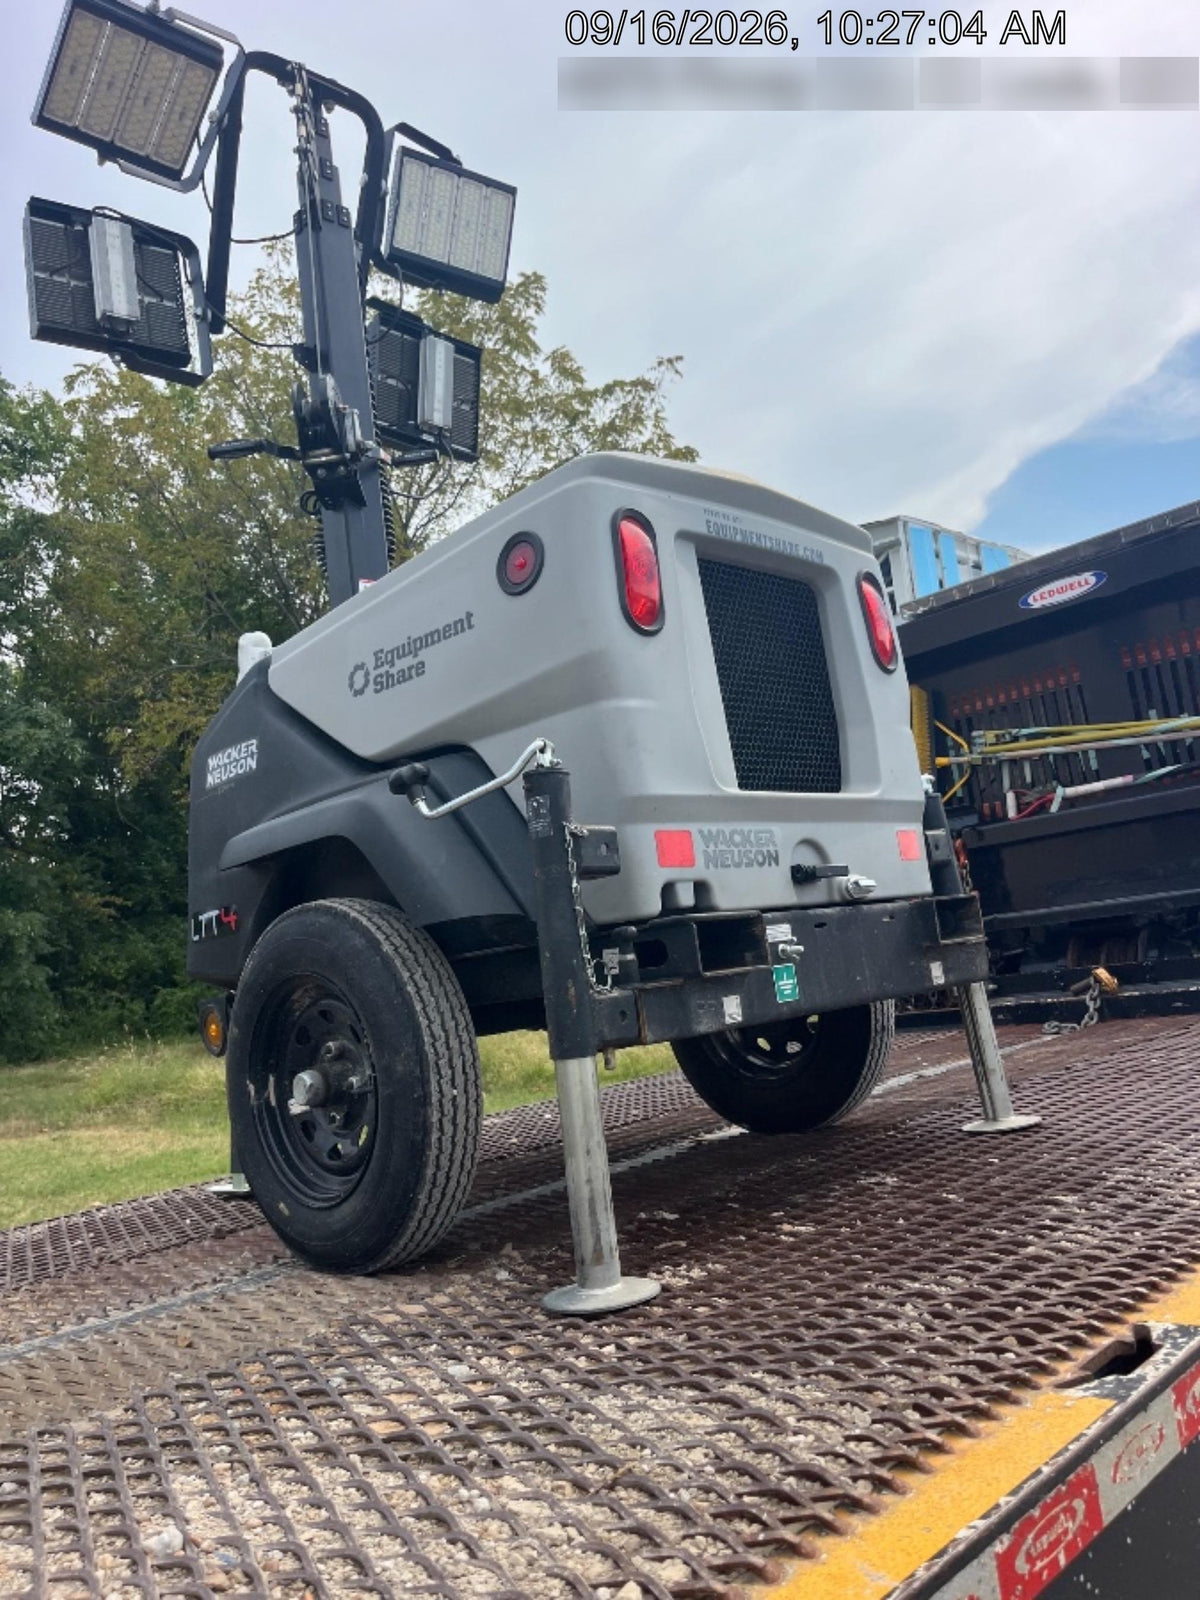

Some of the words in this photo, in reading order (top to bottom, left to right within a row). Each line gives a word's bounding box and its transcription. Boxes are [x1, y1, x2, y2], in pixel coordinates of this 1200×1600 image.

[1032, 577, 1092, 603] LEDWELL
[373, 610, 475, 671] Equipment
[373, 660, 426, 694] Share
[207, 739, 259, 771] WACKER
[206, 754, 258, 789] NEUSON
[698, 828, 778, 849] WACKER
[702, 848, 780, 869] NEUSON
